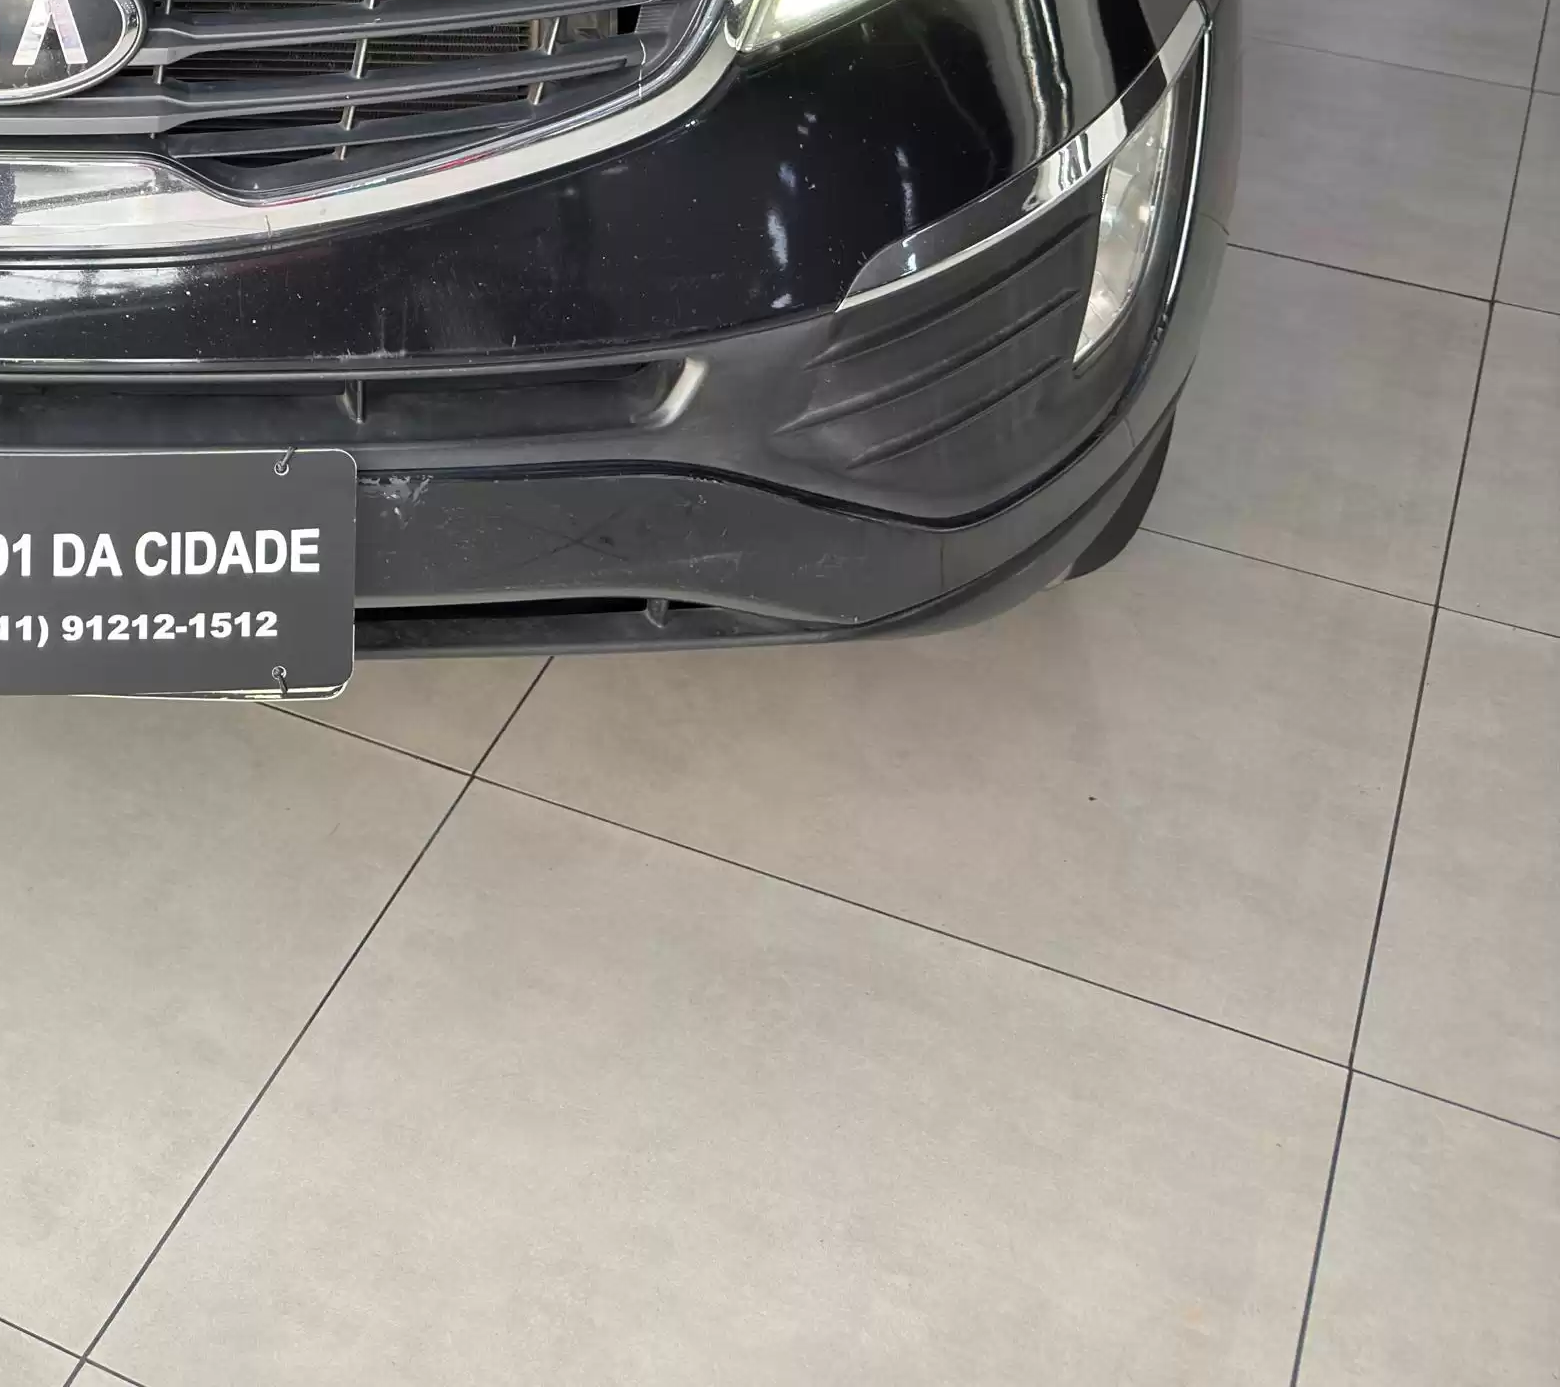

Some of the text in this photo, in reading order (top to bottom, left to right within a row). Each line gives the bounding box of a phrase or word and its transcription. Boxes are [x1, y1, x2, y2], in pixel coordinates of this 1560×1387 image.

[52, 532, 123, 577] DA
[134, 527, 321, 577] CIDADE
[61, 610, 278, 642] 91212-1512
